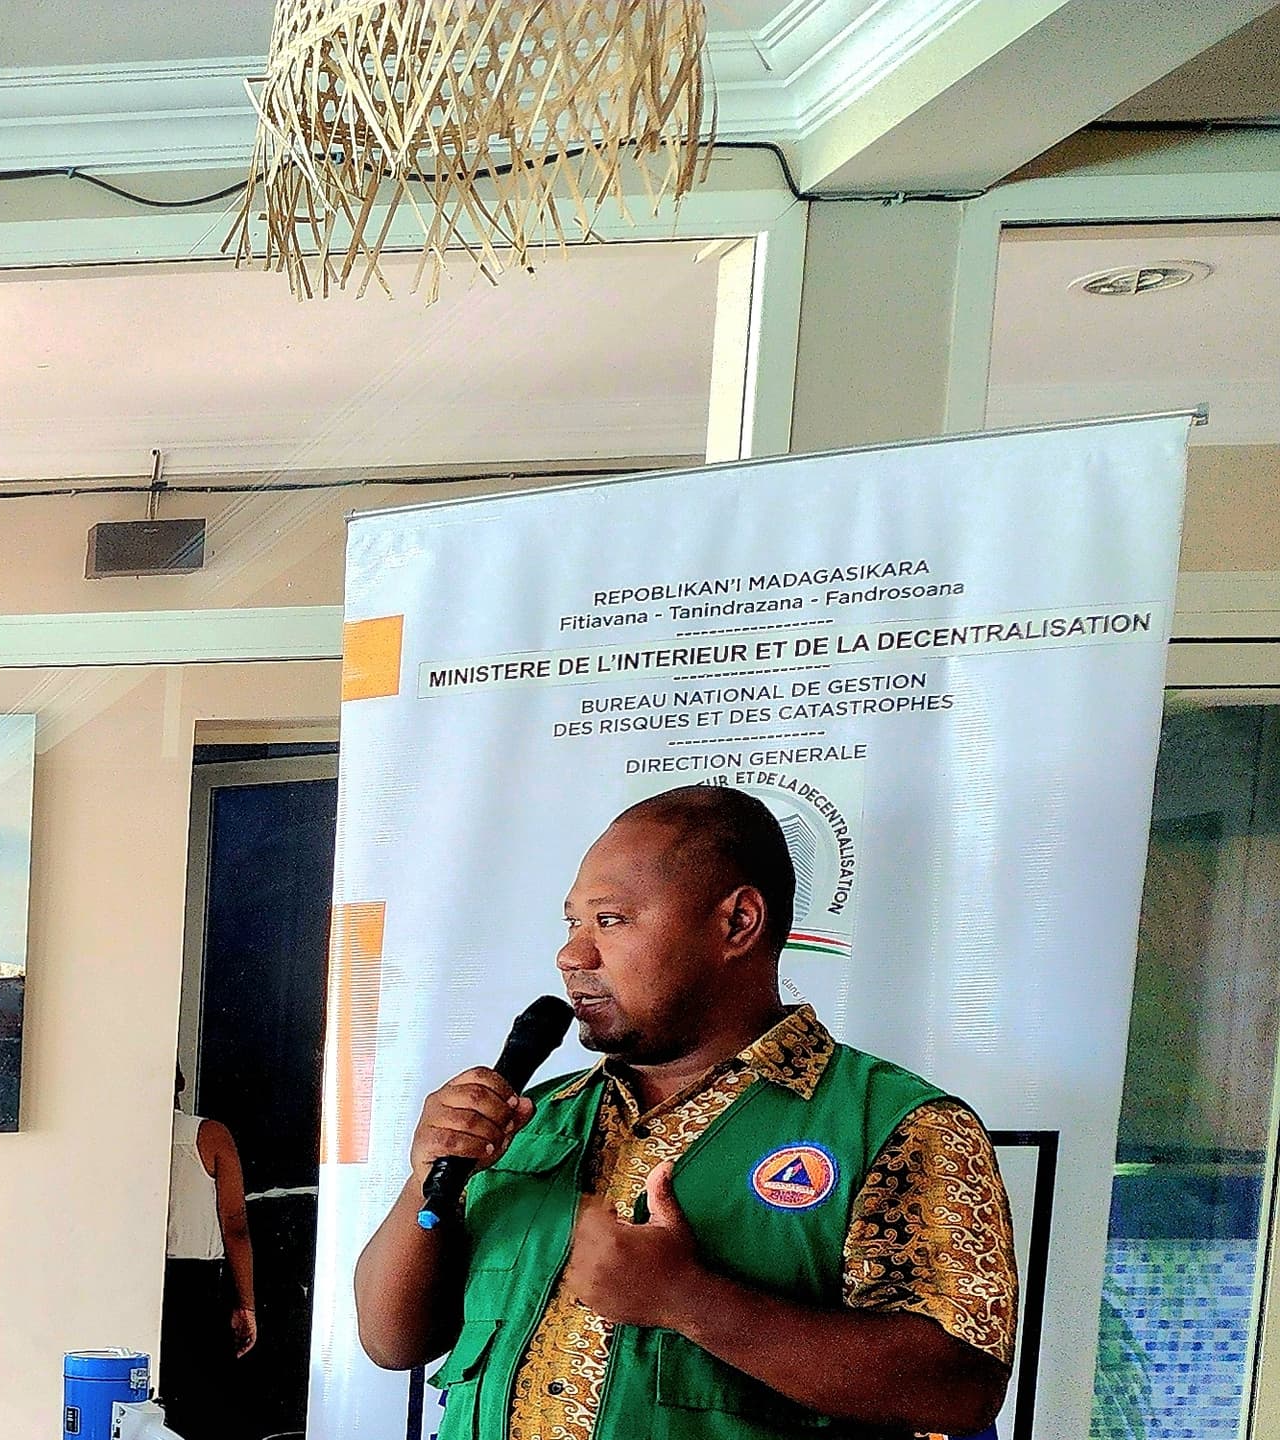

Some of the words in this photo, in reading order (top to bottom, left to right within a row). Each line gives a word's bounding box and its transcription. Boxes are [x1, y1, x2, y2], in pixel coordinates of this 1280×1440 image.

[594, 578, 741, 606] REPOBLIKAN'I
[748, 560, 930, 591] MADAGASIKARA
[560, 611, 648, 631] Fitiavana
[669, 597, 803, 619] Tanindrazana
[826, 583, 964, 606] Fandrosoana
[429, 660, 550, 688] MINISTERE
[558, 656, 590, 676] DE
[597, 645, 747, 673] L'INTERIEUR
[755, 641, 788, 660] ET
[794, 637, 828, 657] DE
[837, 634, 869, 654] LA
[877, 612, 1151, 651] DECENTRALISATION
[553, 721, 592, 738] DES
[599, 714, 689, 734] RISQUES
[697, 711, 723, 727] ET
[729, 708, 771, 725] DES
[778, 694, 954, 721] CATASTROPHES
[581, 693, 666, 714] BUREAU
[673, 685, 784, 707] NATIONAL
[791, 681, 821, 698] DE
[828, 673, 927, 694] GESTION
[625, 753, 742, 774] DIRECTION
[749, 744, 867, 766] GENERALE
[736, 771, 755, 784] ET
[757, 771, 775, 785] DE
[778, 775, 798, 792] LA
[798, 783, 855, 915] DECENTRALISATION
